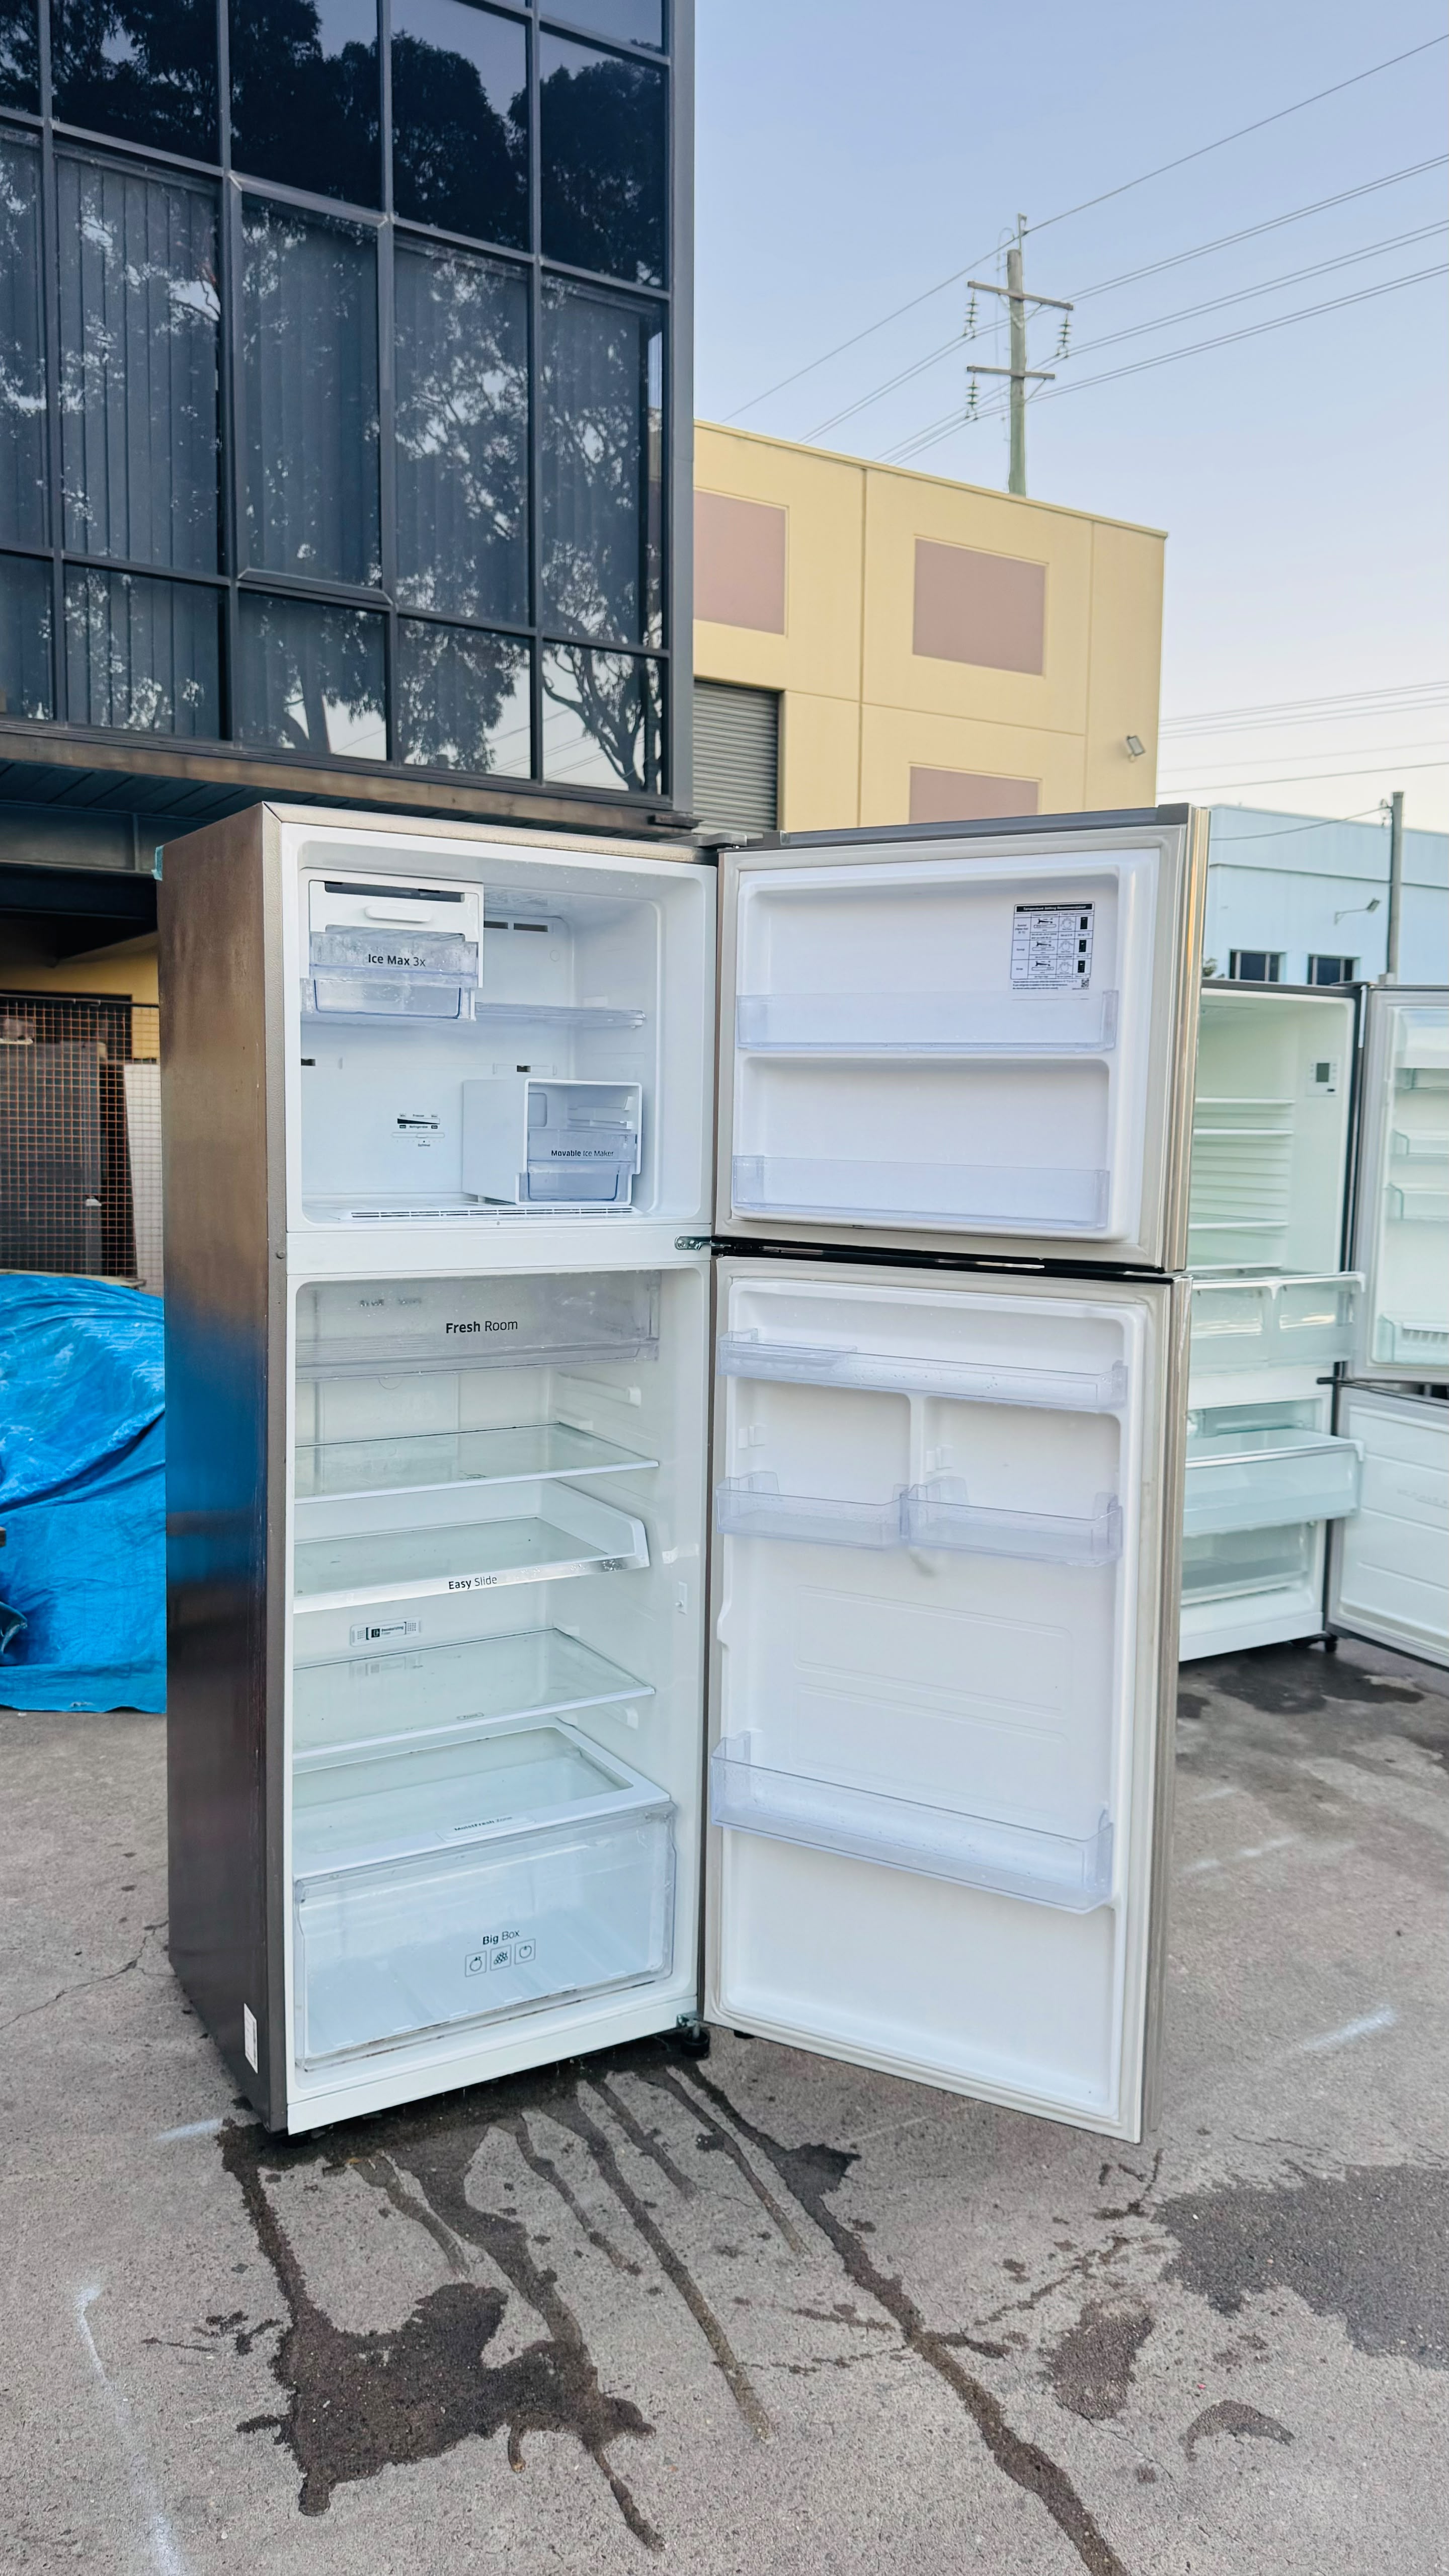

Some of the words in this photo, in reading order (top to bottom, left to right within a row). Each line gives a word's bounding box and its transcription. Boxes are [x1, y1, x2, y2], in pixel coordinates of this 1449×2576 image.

[368, 954, 384, 964] Ice
[387, 955, 410, 965] Max
[413, 957, 426, 967] 3x
[446, 1321, 480, 1333] Fresh
[485, 1321, 518, 1332] Room
[449, 1580, 471, 1589] Easy
[474, 1576, 497, 1586] Slide
[483, 1935, 499, 1945] Big
[502, 1930, 520, 1941] Box
